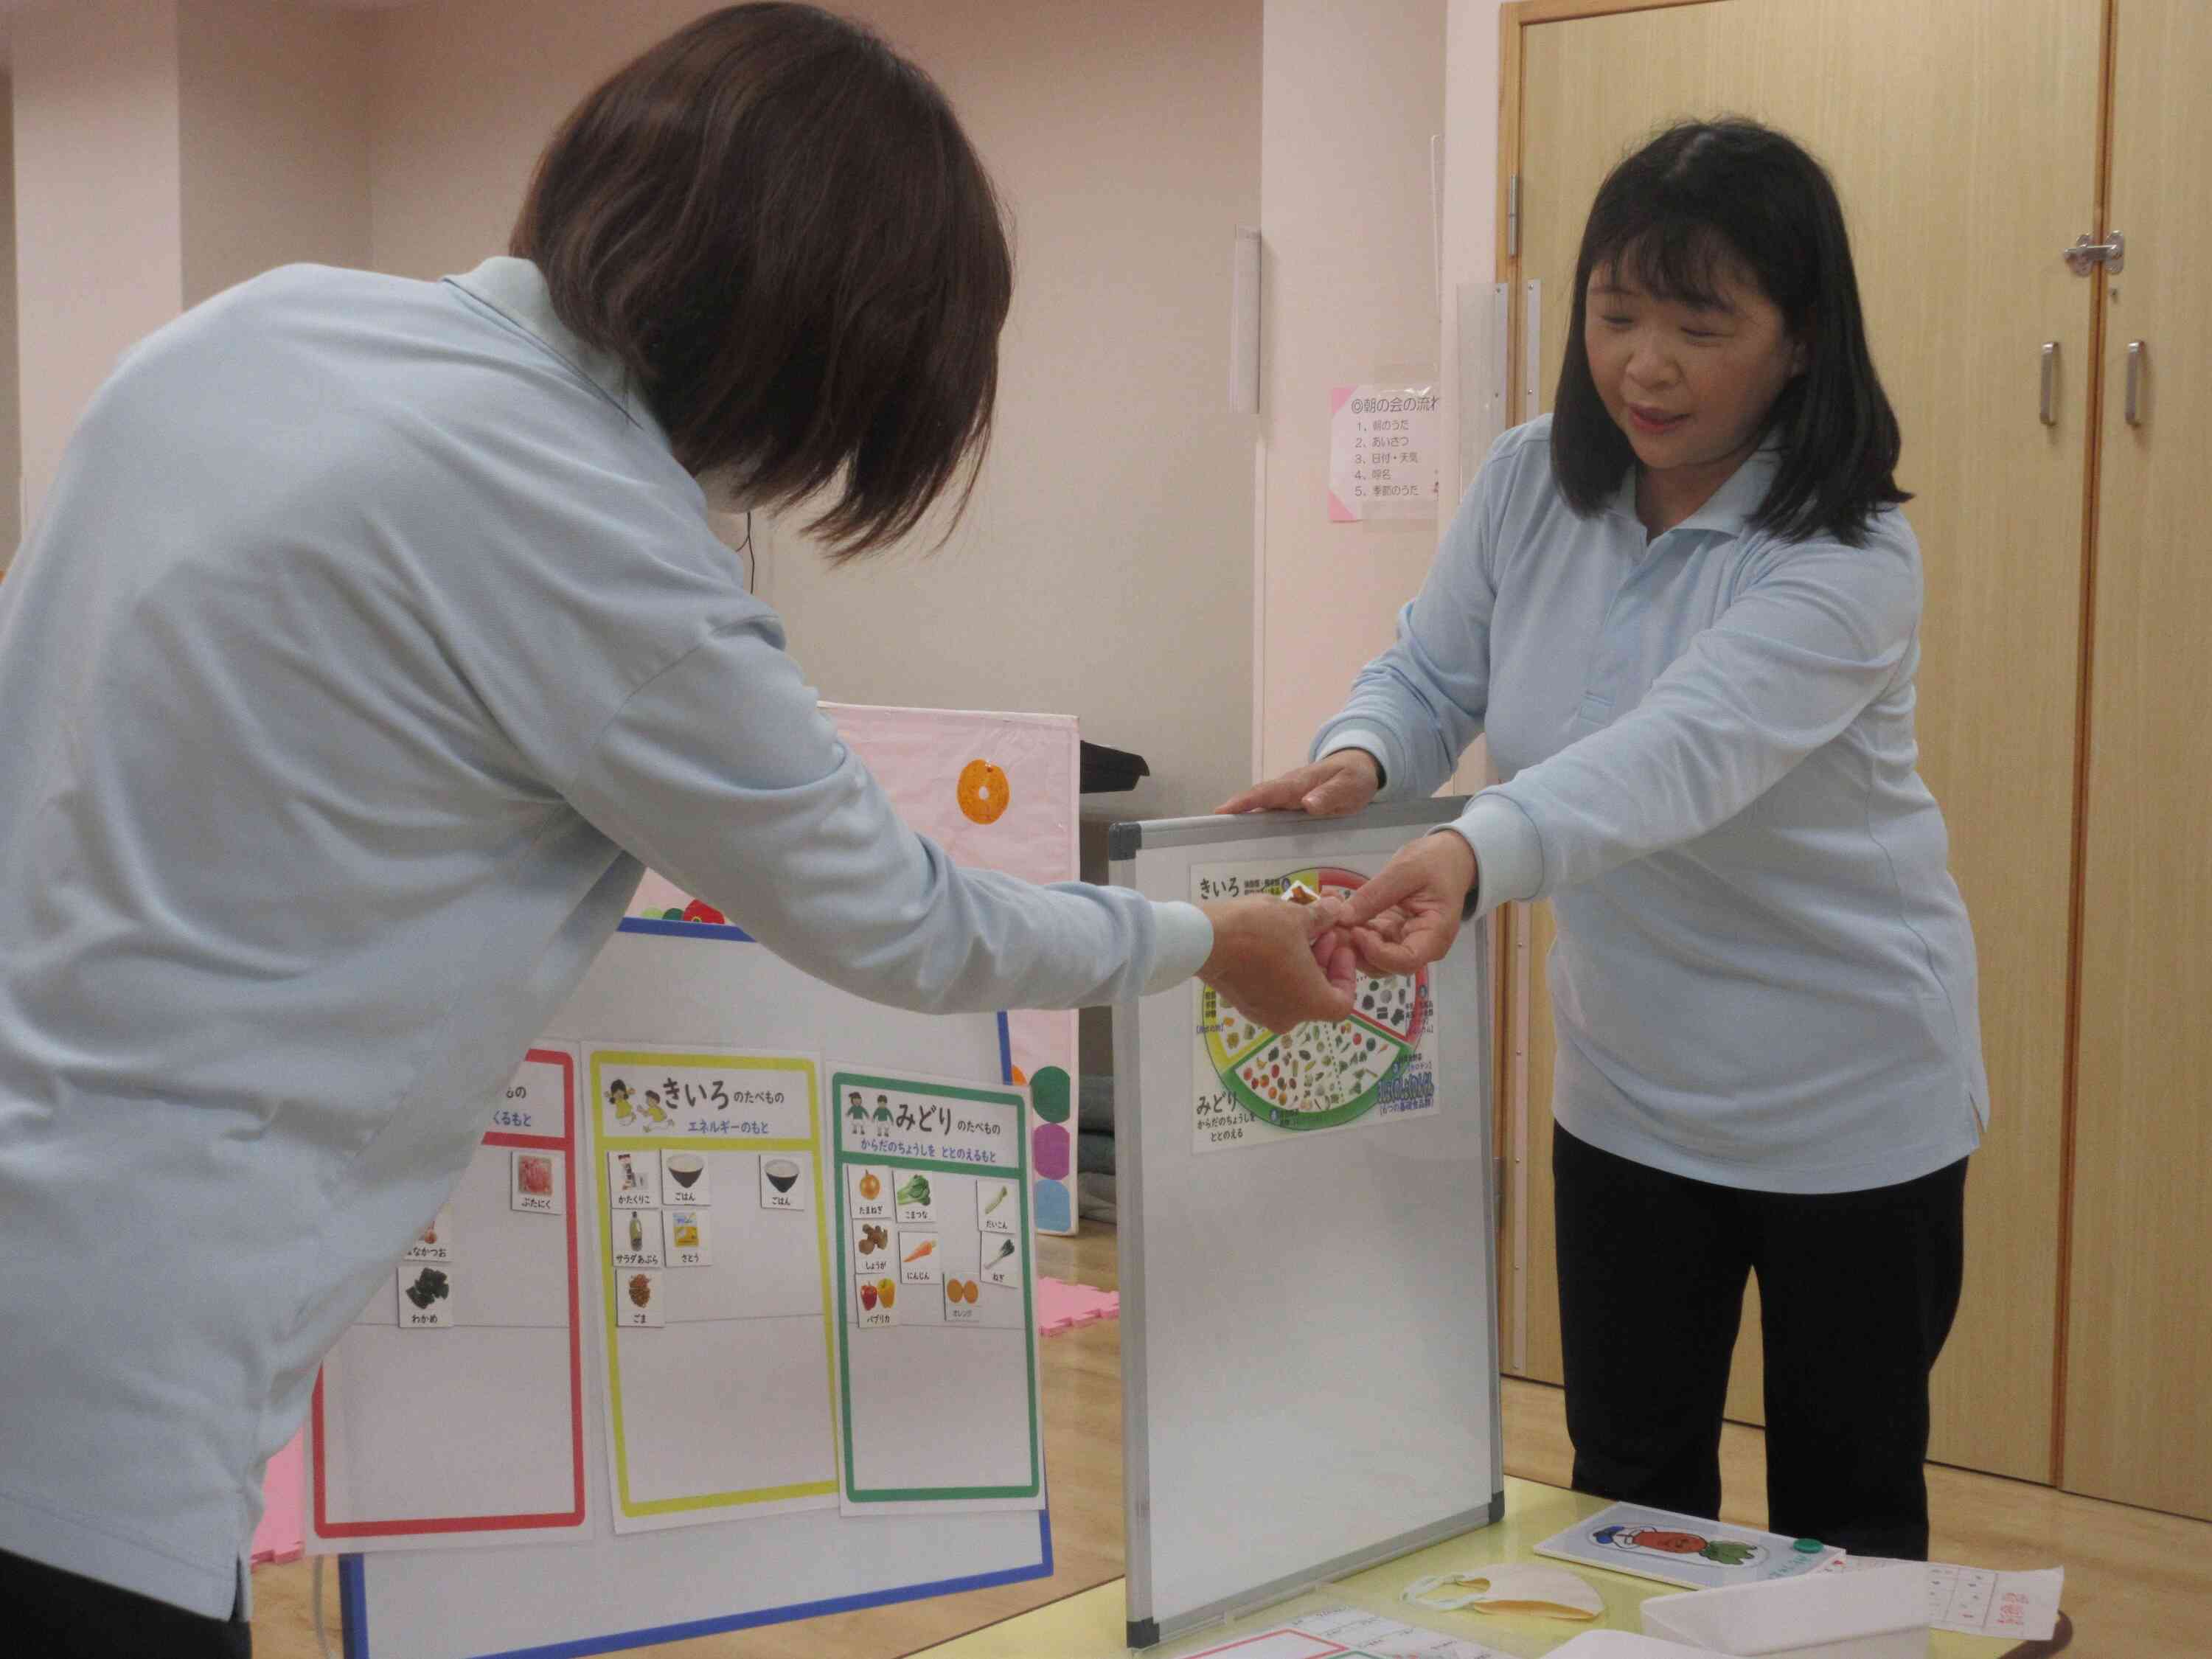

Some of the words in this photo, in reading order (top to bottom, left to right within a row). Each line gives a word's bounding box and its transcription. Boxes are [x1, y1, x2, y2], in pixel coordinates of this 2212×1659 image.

[1372, 437, 1409, 448] あいさつ
[1200, 877, 1239, 900] きいろ
[662, 1077, 729, 1110] きいろ
[734, 1091, 785, 1105] のたべもの
[1197, 1091, 1237, 1116] みどり
[896, 1104, 952, 1135] みどり
[958, 1121, 1001, 1135] のたべもの
[688, 1119, 769, 1134] エネルギーのもと
[1211, 1128, 1243, 1142] ととのえる
[860, 1138, 935, 1157] からだのちょうしを
[942, 1145, 996, 1163] ととのえるもと
[618, 1194, 651, 1205] かたくりこ
[675, 1192, 695, 1202] ごはん
[772, 1196, 791, 1206] ごはん
[521, 1197, 551, 1209] ぶたにく
[859, 1205, 883, 1215] たまねぎ
[905, 1210, 928, 1220] こまつな
[986, 1220, 1008, 1230] だいこん
[408, 1247, 447, 1258] なかつお
[681, 1253, 700, 1263] さとう
[616, 1253, 658, 1265] サラダあぶら
[865, 1260, 887, 1270] しょうが
[906, 1272, 930, 1281] にんじん
[992, 1273, 1005, 1282] ねぎ
[411, 1314, 438, 1324] わかめ
[633, 1313, 647, 1324] ごま
